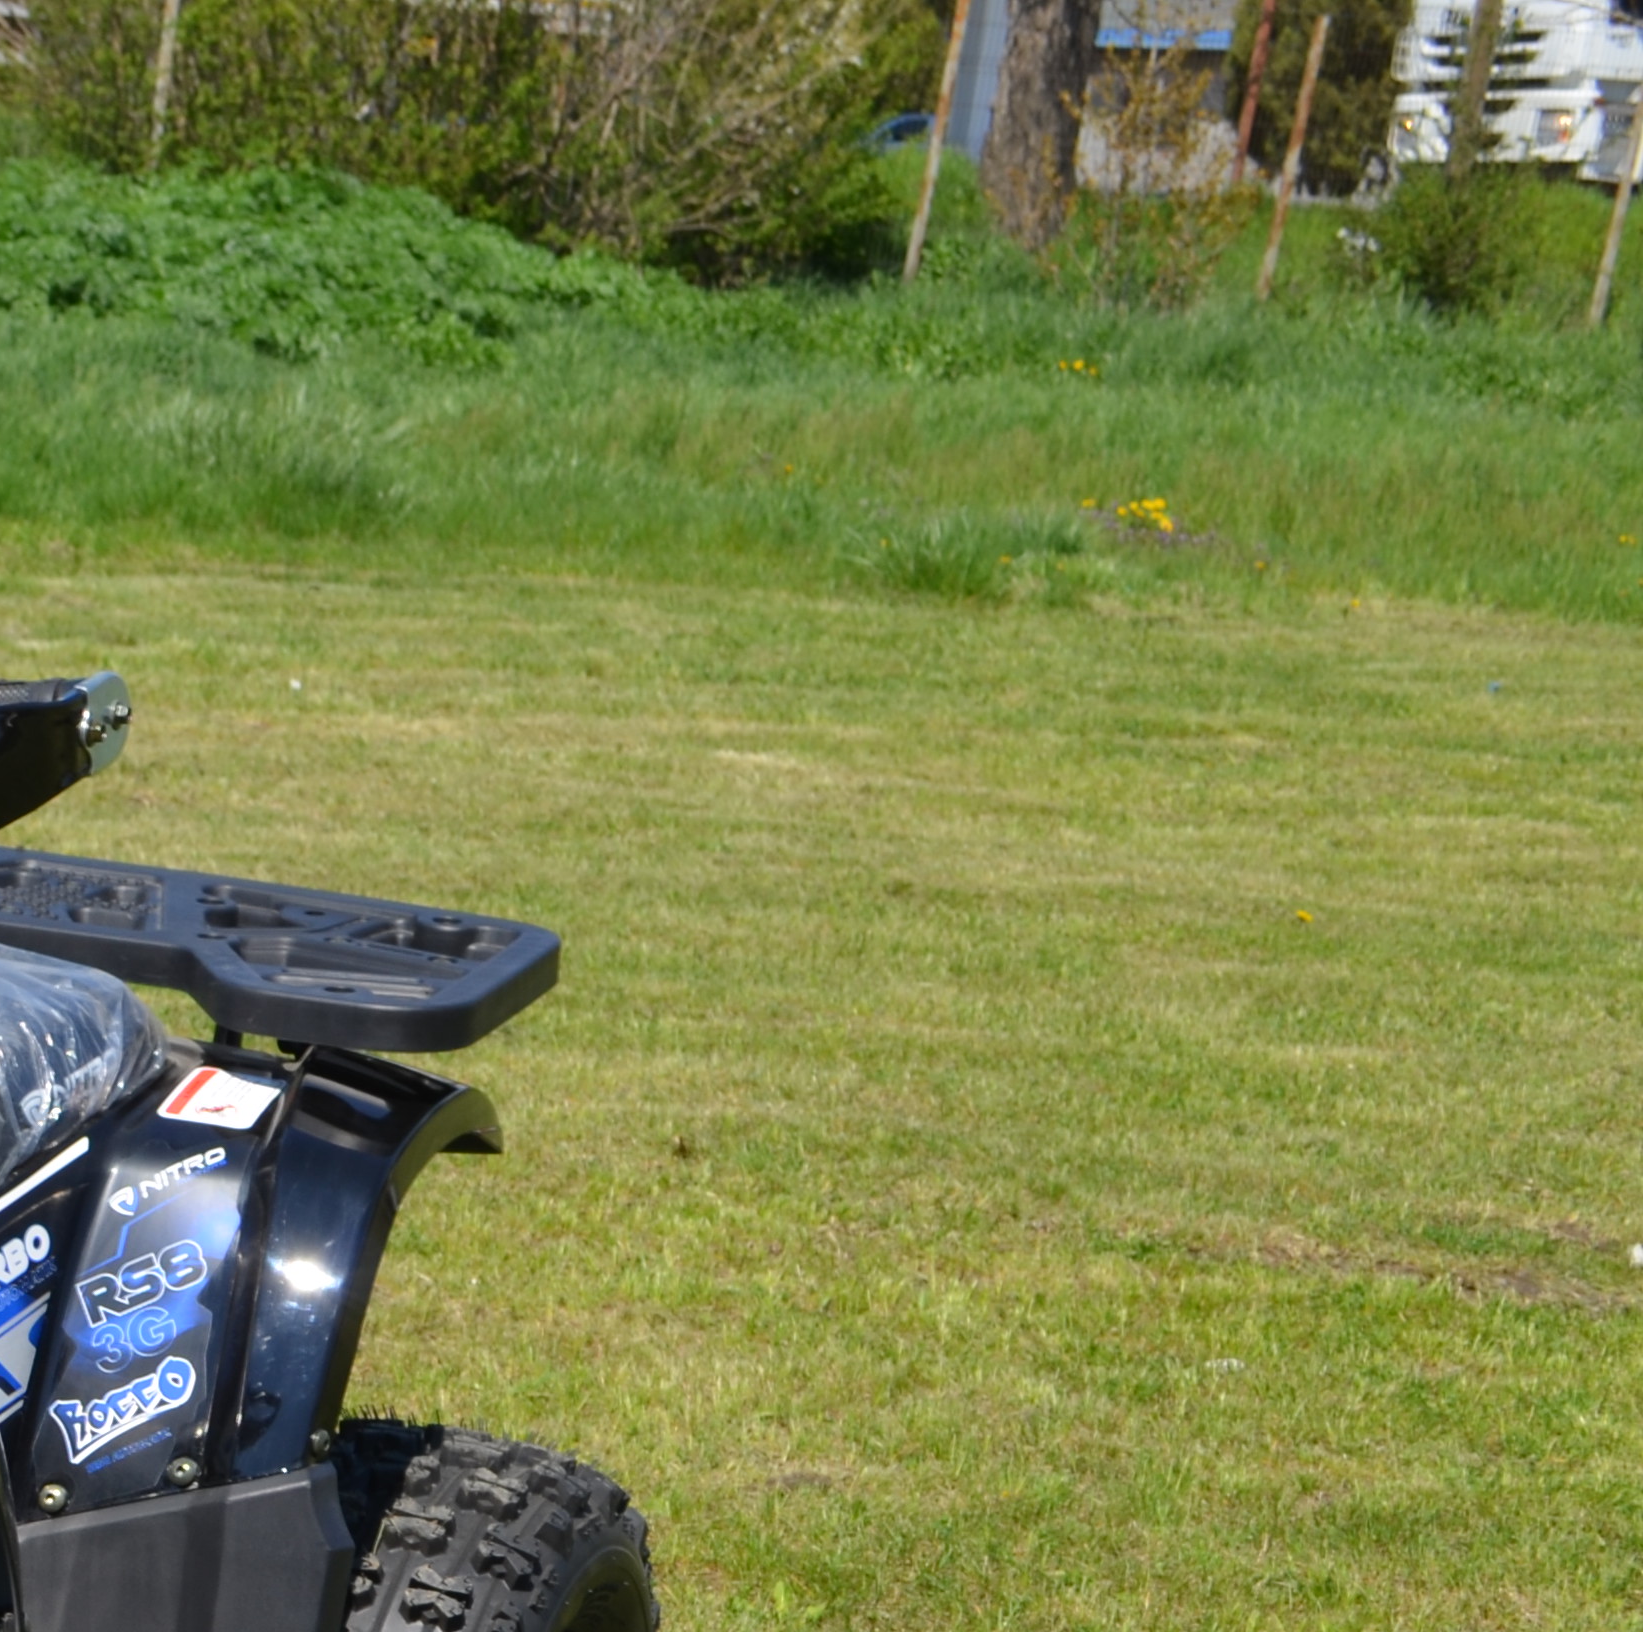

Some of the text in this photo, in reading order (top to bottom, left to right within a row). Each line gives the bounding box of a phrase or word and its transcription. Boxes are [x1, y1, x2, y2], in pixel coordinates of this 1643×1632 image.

[139, 1146, 226, 1199] NITRO
[75, 1239, 208, 1329] RS8
[92, 1306, 177, 1374] 3G
